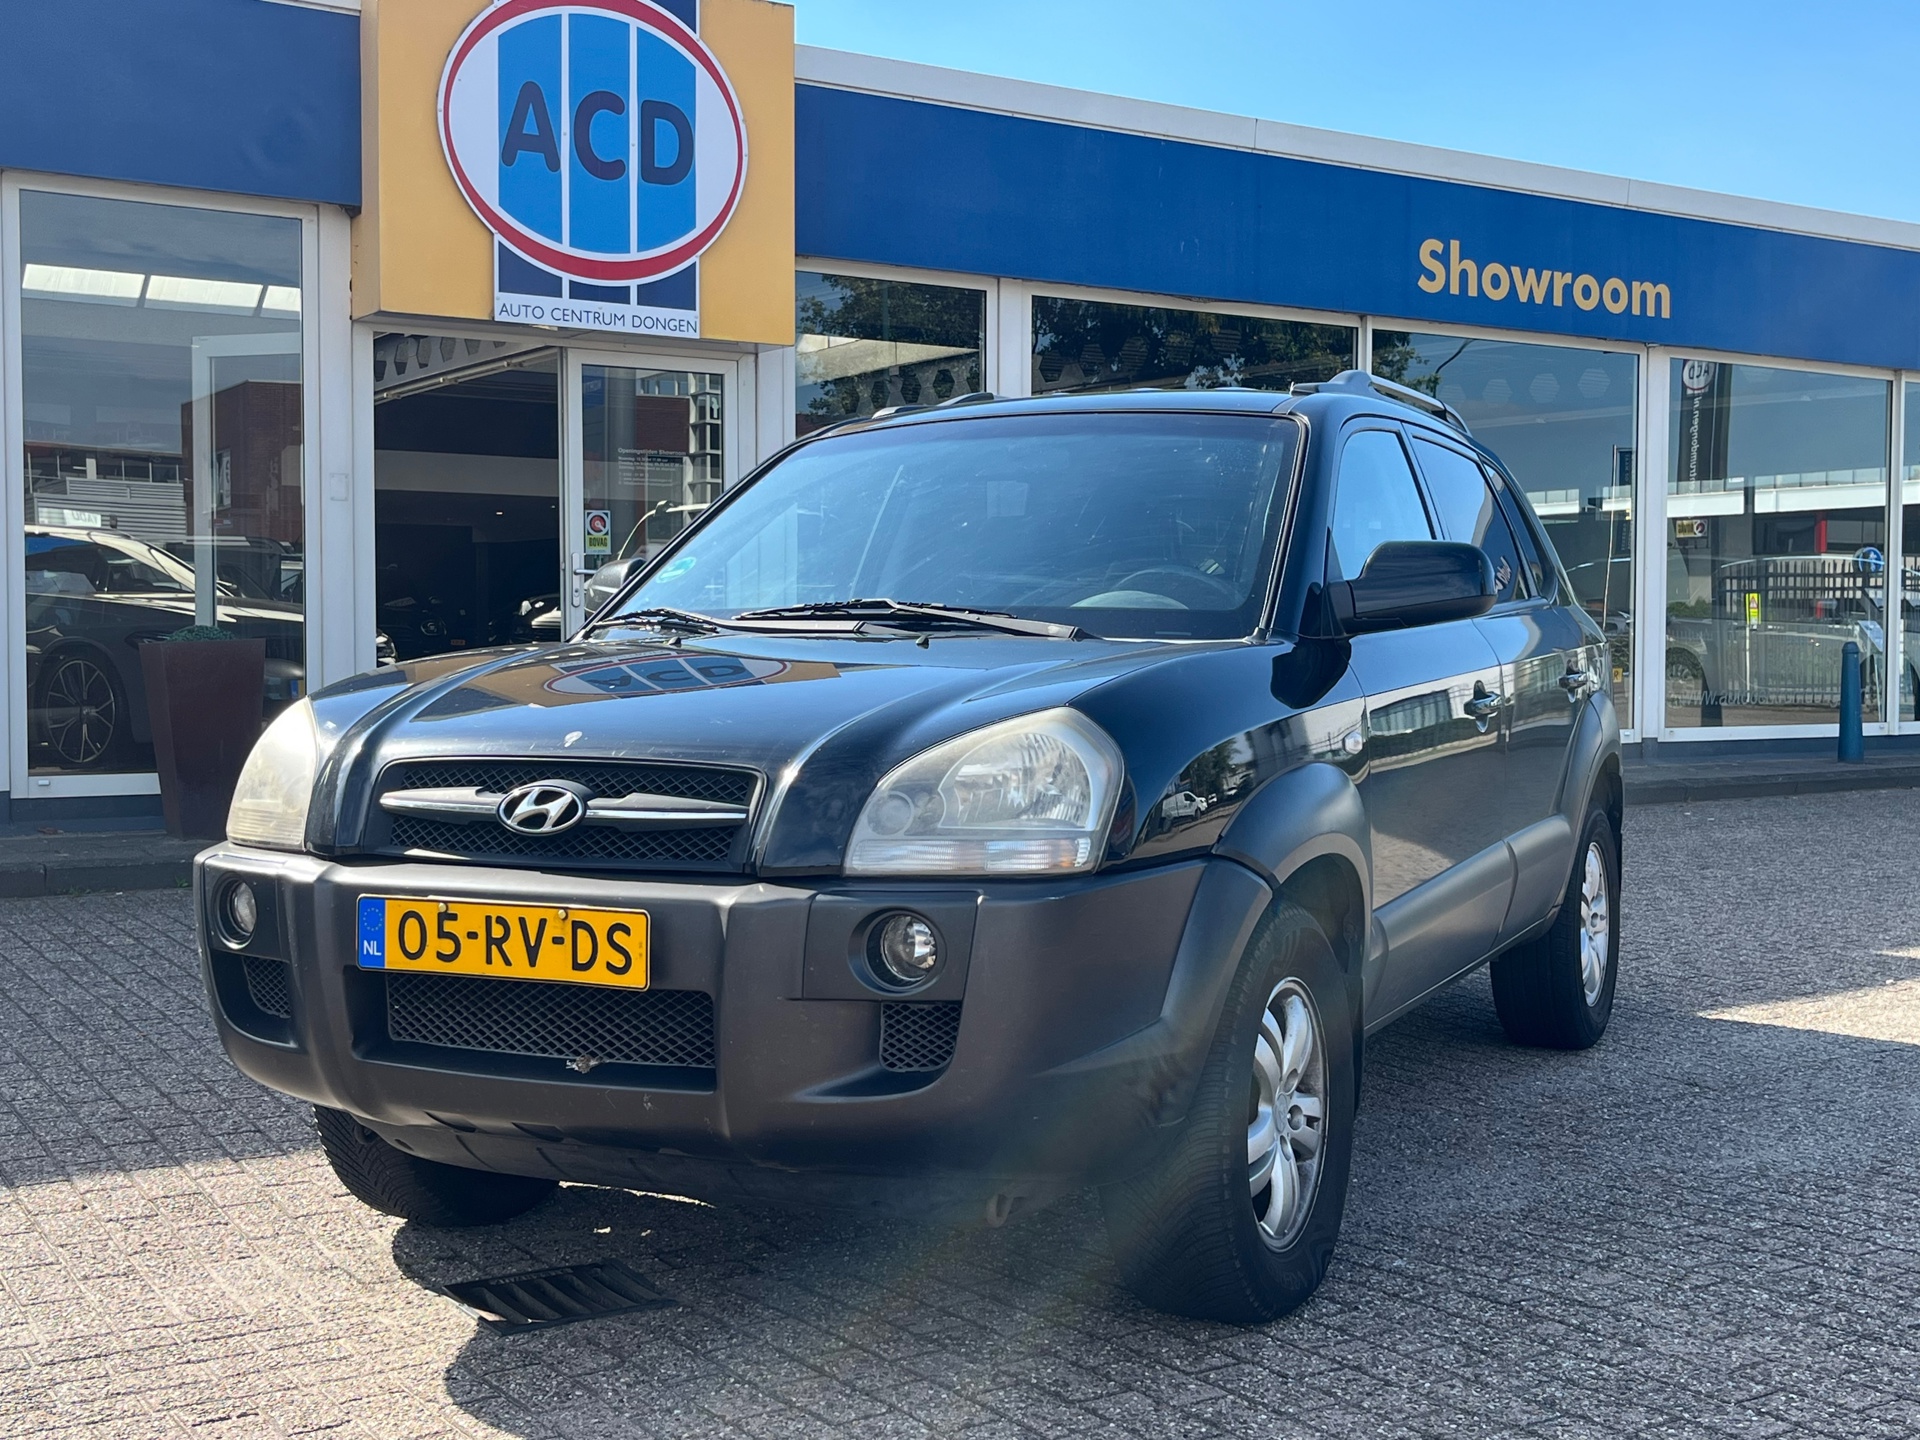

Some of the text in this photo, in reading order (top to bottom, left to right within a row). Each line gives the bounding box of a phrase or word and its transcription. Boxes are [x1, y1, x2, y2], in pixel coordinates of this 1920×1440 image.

[501, 80, 695, 186] ACD
[1417, 238, 1671, 319] Showroom
[498, 303, 698, 334] AUTO CENTRUM DONGEN
[588, 537, 608, 547] BOVAG
[363, 939, 383, 956] NL
[398, 909, 633, 976] 05-RV-DS
